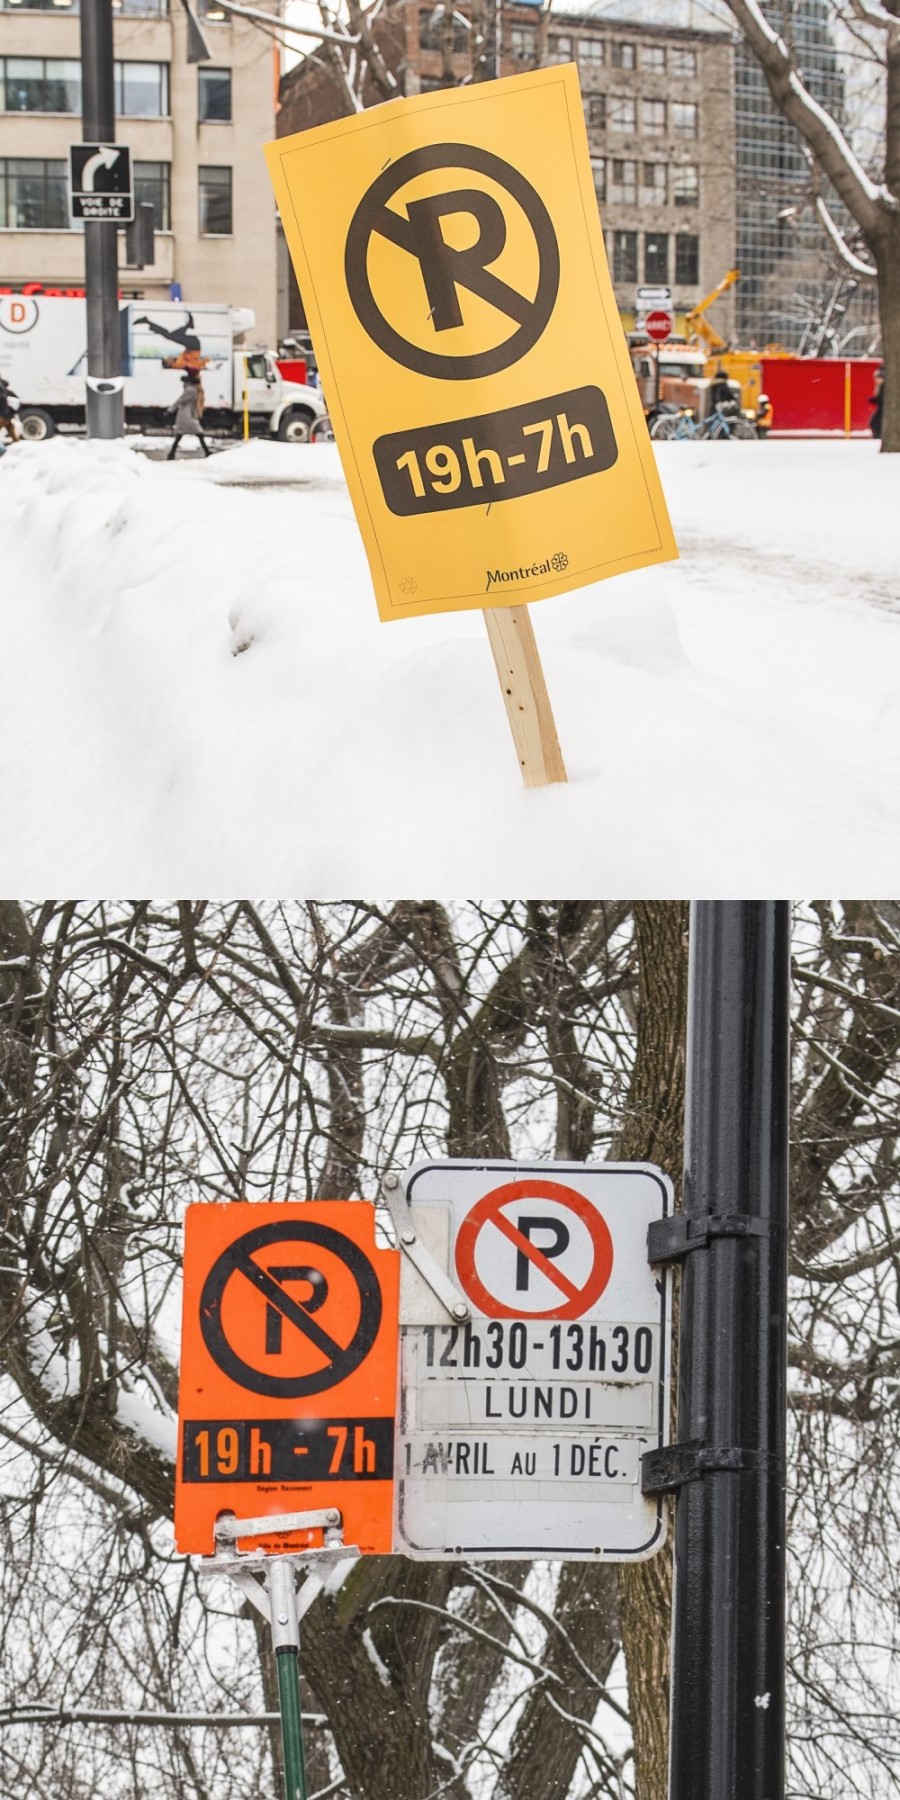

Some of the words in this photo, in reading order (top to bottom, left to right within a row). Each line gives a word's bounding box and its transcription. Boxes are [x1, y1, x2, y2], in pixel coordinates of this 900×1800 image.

[80, 198, 103, 207] VOIE
[109, 198, 124, 207] DE
[83, 206, 121, 217] DROITE
[11, 303, 25, 322] D
[395, 413, 594, 498] 19h-7h
[486, 559, 551, 583] Montréal
[422, 1321, 653, 1374] 12h30-13h30
[485, 1386, 591, 1419] LUNDI
[327, 1426, 376, 1474] 7h
[404, 1443, 411, 1475] 1
[422, 1442, 495, 1475] AVRIL
[511, 1452, 536, 1476] AU
[553, 1443, 560, 1476] 1
[570, 1437, 627, 1478] DÉC.
